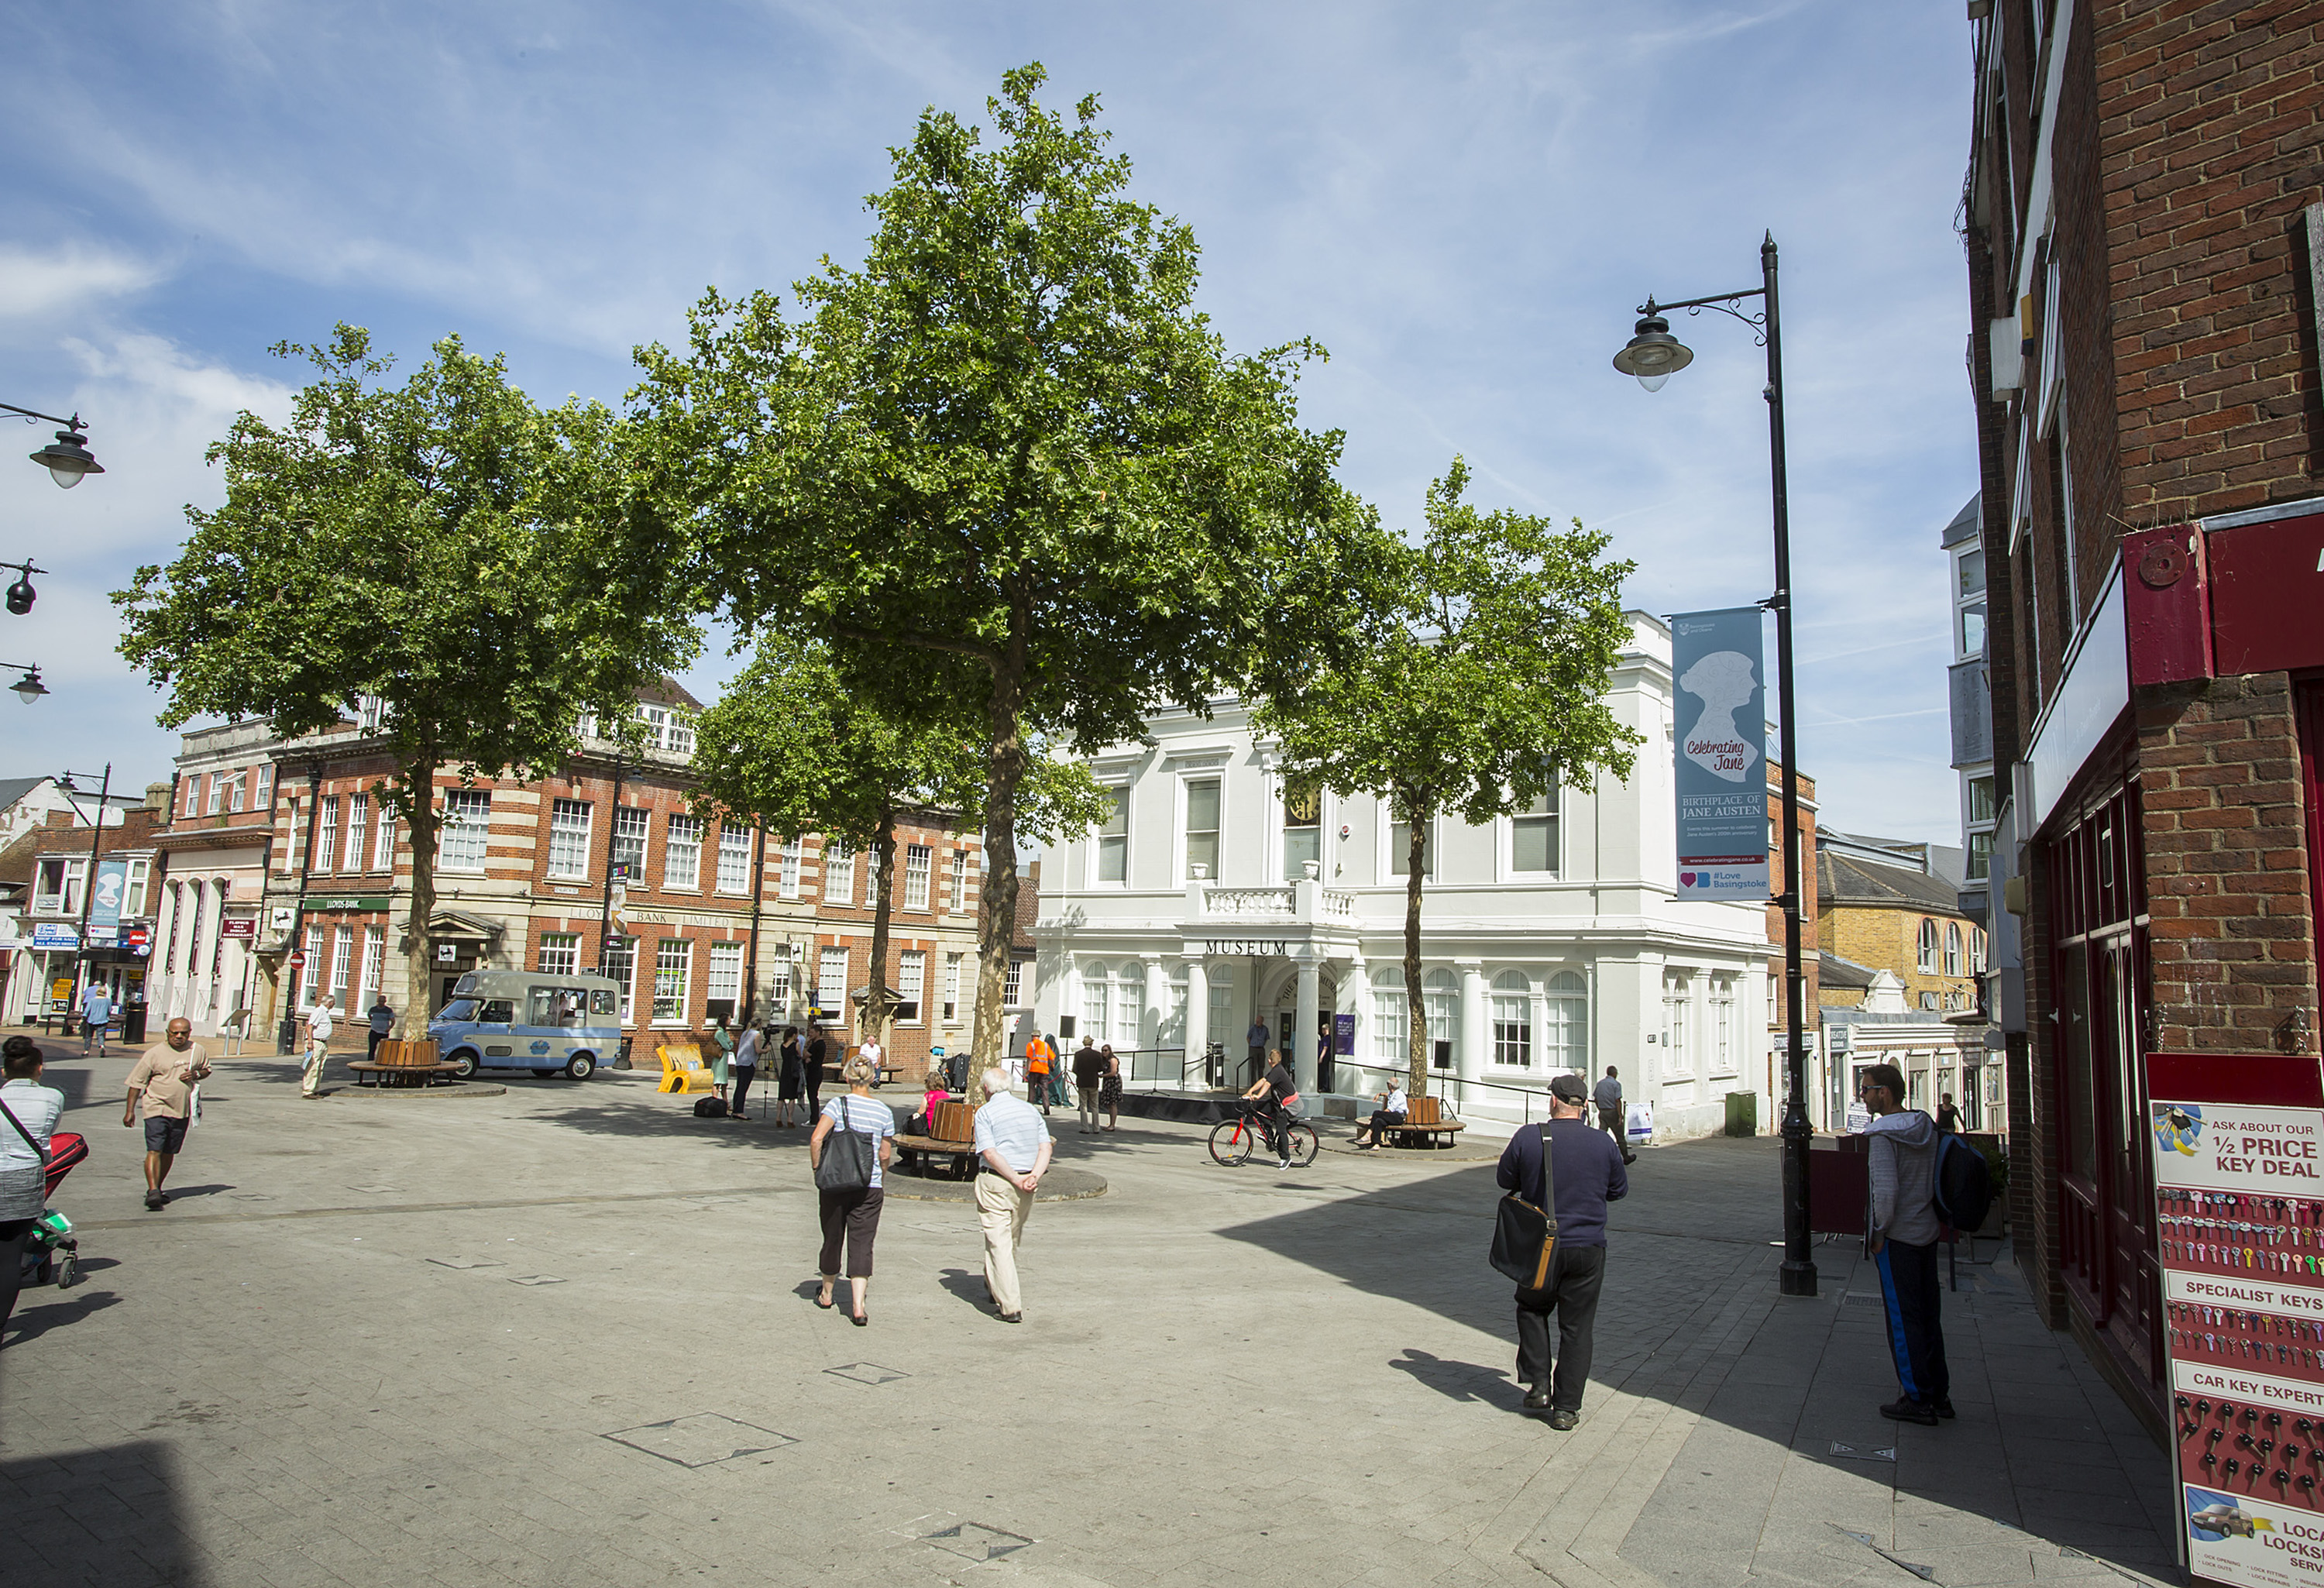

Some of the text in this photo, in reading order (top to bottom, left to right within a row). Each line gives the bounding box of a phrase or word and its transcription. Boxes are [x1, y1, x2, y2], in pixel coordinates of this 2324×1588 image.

[1687, 740, 1745, 756] Celebrating
[1714, 754, 1745, 771] Jane
[1683, 795, 1761, 806] BIRTHPLACE OF
[1682, 806, 1761, 820] JANE AUSTEN
[1714, 871, 1741, 880] #Love
[1714, 879, 1767, 889] Basingstoke
[326, 899, 359, 909] LLOYDS BANK
[570, 907, 730, 927] LLOY BANK LIMITED
[1205, 940, 1287, 955] MUSEUM
[1282, 983, 1294, 1000] THE
[2212, 1120, 2314, 1136] ASK ABOUT OUR
[2242, 1137, 2318, 1159] PRICE
[2216, 1156, 2320, 1178] KEY DEAL
[2186, 1281, 2323, 1311] SPECIALIST KEYS
[2193, 1373, 2226, 1389] CAR
[2229, 1379, 2259, 1394] KEY
[2263, 1534, 2324, 1561] LOCKS
[2216, 1556, 2241, 1567] OPENING
[2266, 1569, 2288, 1579] FITTING
[2267, 1577, 2291, 1588] REPAIRS
